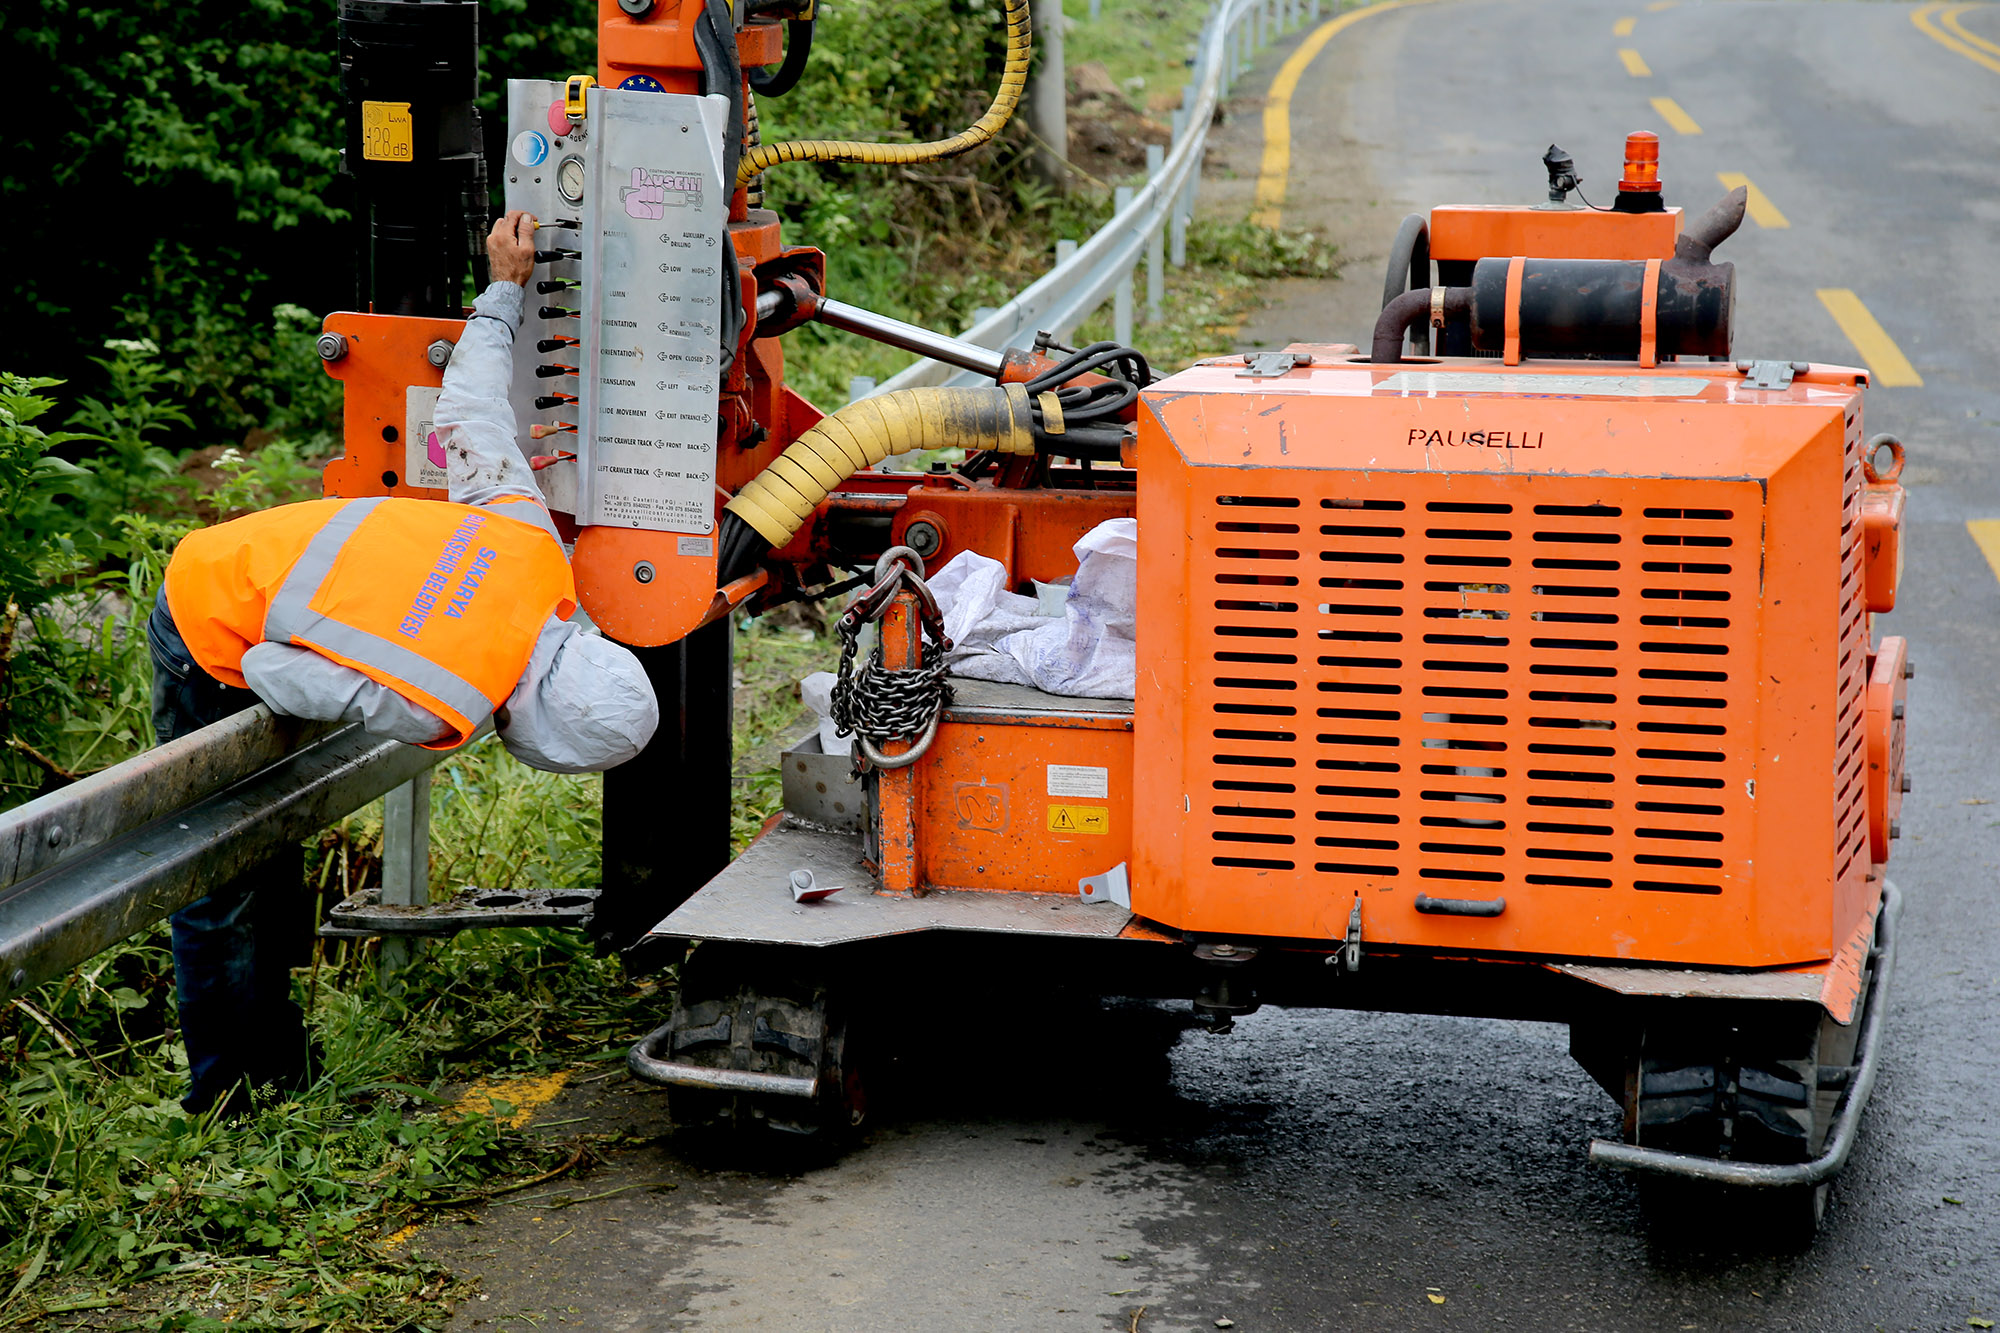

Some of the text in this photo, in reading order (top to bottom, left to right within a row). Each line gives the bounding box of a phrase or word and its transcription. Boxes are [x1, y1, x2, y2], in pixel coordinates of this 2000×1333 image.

[367, 127, 408, 157] 128 dB
[631, 167, 702, 192] PAUSELLI
[683, 231, 705, 239] AUXILIARY
[671, 240, 691, 248] DRILLING
[601, 319, 638, 328] ORIENTATION
[600, 348, 637, 358] ORIENTATION
[668, 353, 682, 361] OPEN
[600, 377, 636, 387] TRANSLATION
[616, 408, 647, 417] MOVEMENT
[680, 413, 701, 421] ENTRANCE
[598, 435, 653, 447] RIGHT CRAWLER TRACK
[1408, 428, 1544, 449] PAUSELLI
[597, 465, 650, 476] LEFT CRAWLER TRACK
[686, 472, 699, 480] BACK
[685, 500, 703, 508] ITALY
[444, 547, 497, 619] SAKARYA
